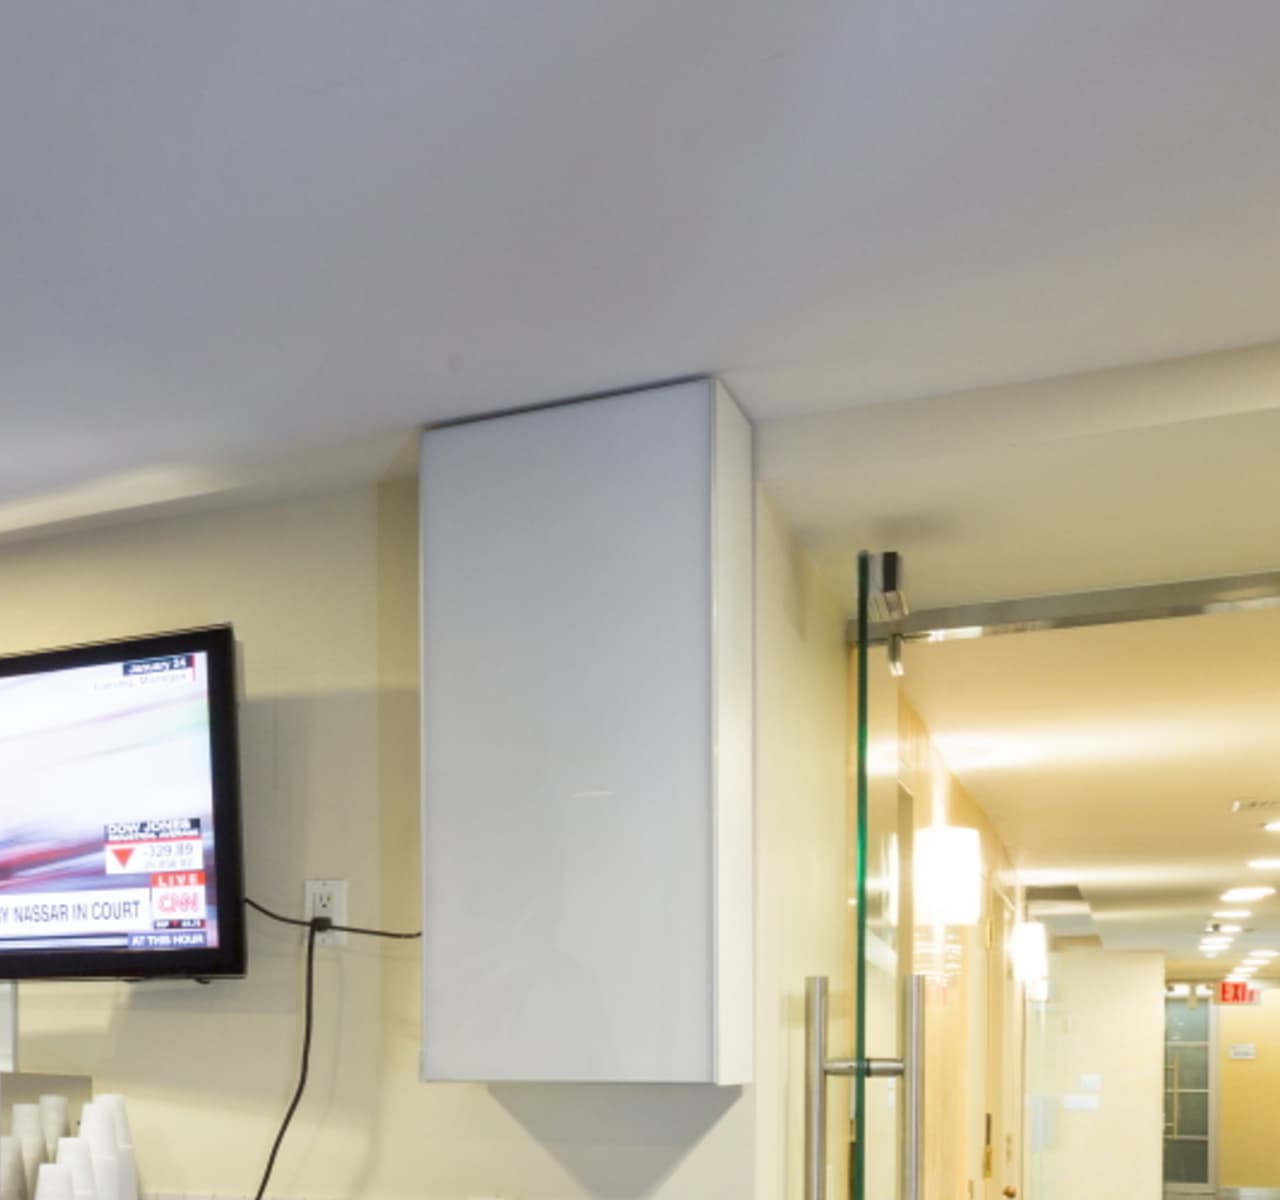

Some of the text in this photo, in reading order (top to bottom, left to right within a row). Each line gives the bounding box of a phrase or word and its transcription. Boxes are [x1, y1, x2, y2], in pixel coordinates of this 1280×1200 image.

[108, 818, 190, 836] DOW JONES
[157, 873, 199, 887] LIVE
[13, 902, 69, 923] NASSAR
[72, 901, 88, 920] IN
[91, 900, 140, 920] COURT
[157, 892, 199, 913] CNN
[131, 933, 204, 946] AT THIS HOUR
